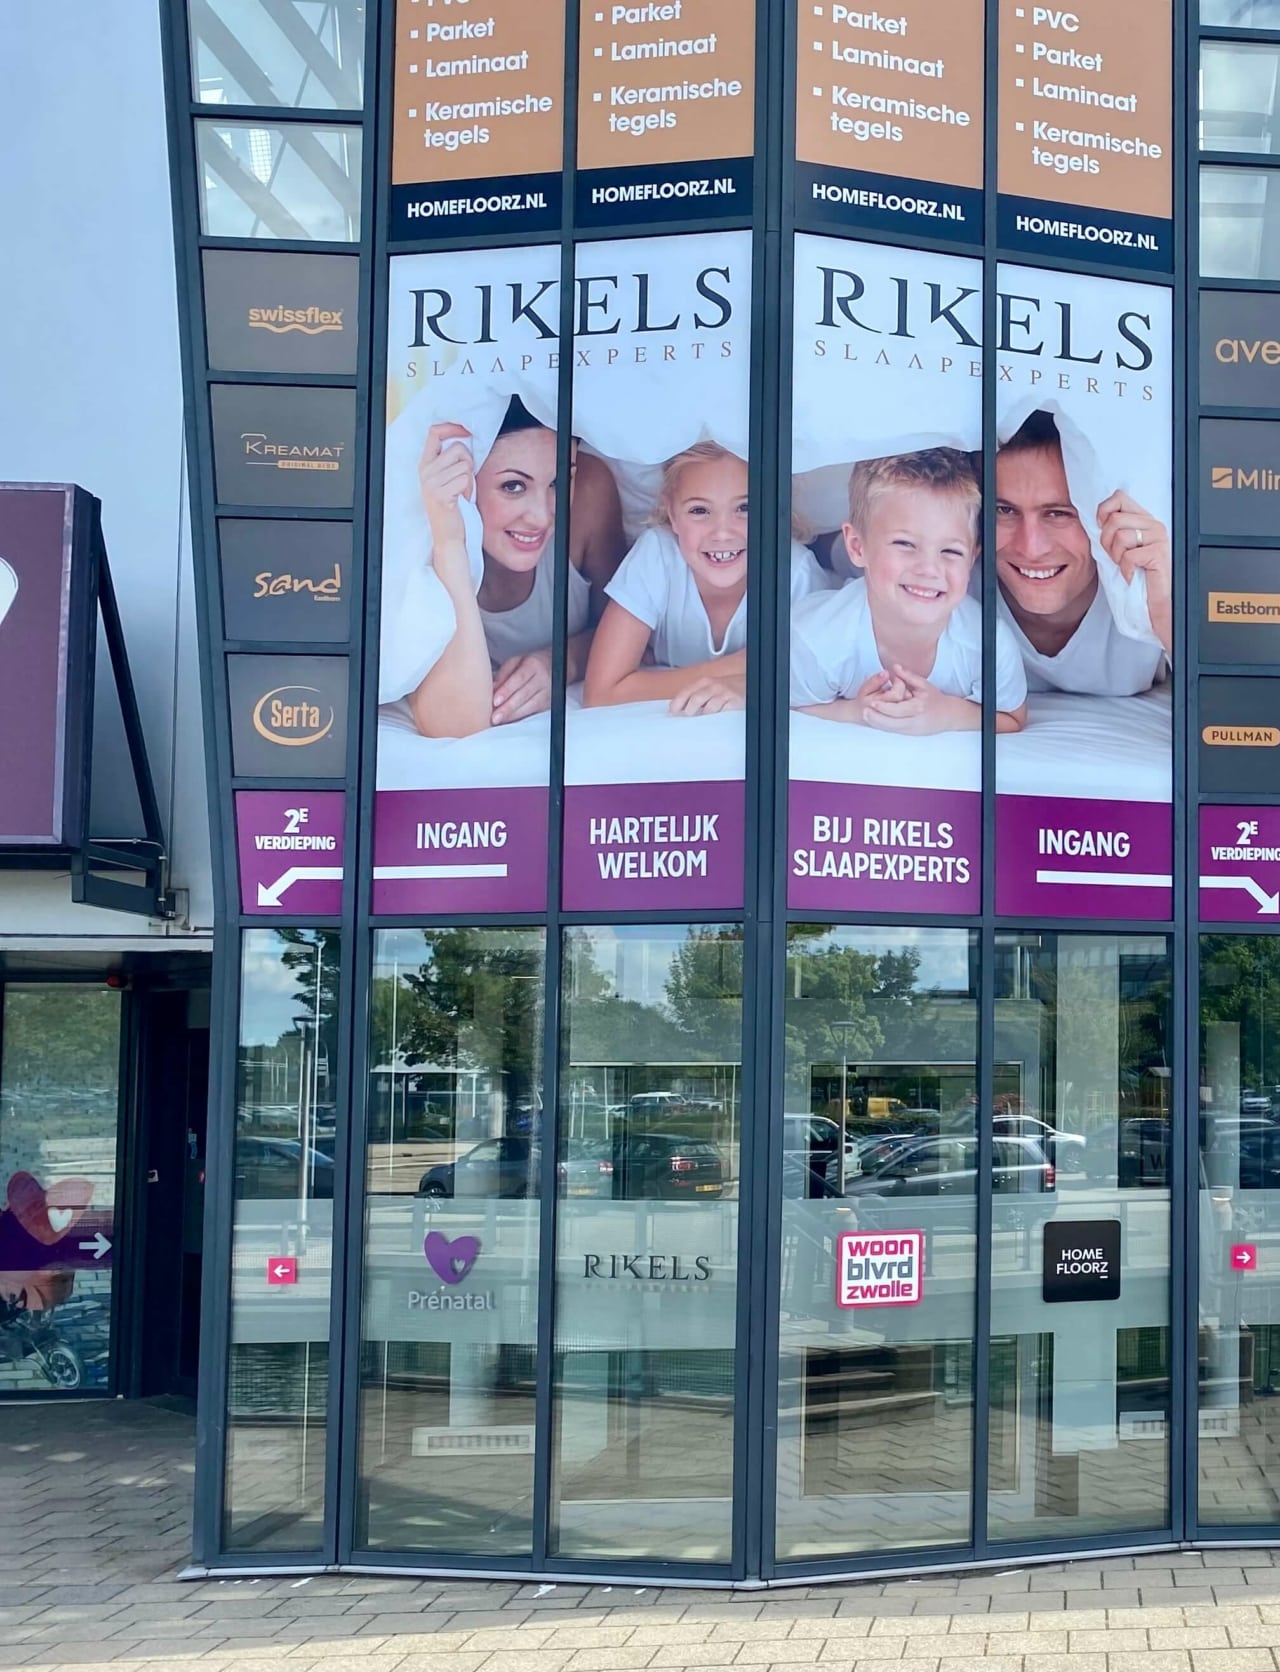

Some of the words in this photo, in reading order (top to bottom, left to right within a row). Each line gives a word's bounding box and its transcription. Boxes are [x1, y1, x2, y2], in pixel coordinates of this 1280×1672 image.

[611, 2, 682, 26] Parket
[832, 4, 907, 36] Parket
[1033, 7, 1080, 33] PVC
[426, 18, 495, 42] Parket
[610, 33, 717, 61] Laminaat
[832, 41, 944, 79] Laminaat
[1033, 42, 1103, 72] Parket
[426, 50, 528, 78] Laminaat
[610, 77, 742, 106] Keramische
[1033, 77, 1137, 112] Laminaat
[425, 94, 552, 121] Keramische
[832, 85, 970, 127] Keramische
[608, 109, 677, 136] tegels
[830, 112, 903, 142] tegels
[423, 125, 490, 151] tegels
[1033, 120, 1162, 159] Keramische
[1031, 146, 1100, 175] tegels
[592, 178, 736, 204] HOMEFLOORZ.NL
[812, 183, 965, 222] HOMEFLOORZ.NL
[407, 193, 547, 218] HOMEFLOORZ.NL
[1016, 215, 1159, 251] HOMEFLOORZ.NL
[249, 305, 343, 325] swissflex
[408, 266, 733, 348] RIKELS
[815, 265, 1153, 372] RIKELS
[271, 699, 320, 728] Serta
[1212, 730, 1273, 742] PULLMAN
[255, 835, 336, 851] VERDIEPING
[416, 821, 507, 849] INGANG
[589, 814, 719, 845] HARTELIJK
[813, 815, 852, 844] BIJ
[863, 818, 953, 850] RIKELS
[1038, 828, 1130, 858] INGANG
[598, 850, 708, 880] WELKOM
[793, 849, 970, 884] SLAAPEXPERTS
[848, 1240, 913, 1257] woon
[1062, 1248, 1103, 1260] HOME
[583, 1254, 710, 1281] RIKELS
[848, 1256, 913, 1281] blvrd
[1056, 1262, 1108, 1277] FLOORZ
[408, 1290, 492, 1310] Prénatal
[847, 1280, 913, 1300] zwolle
